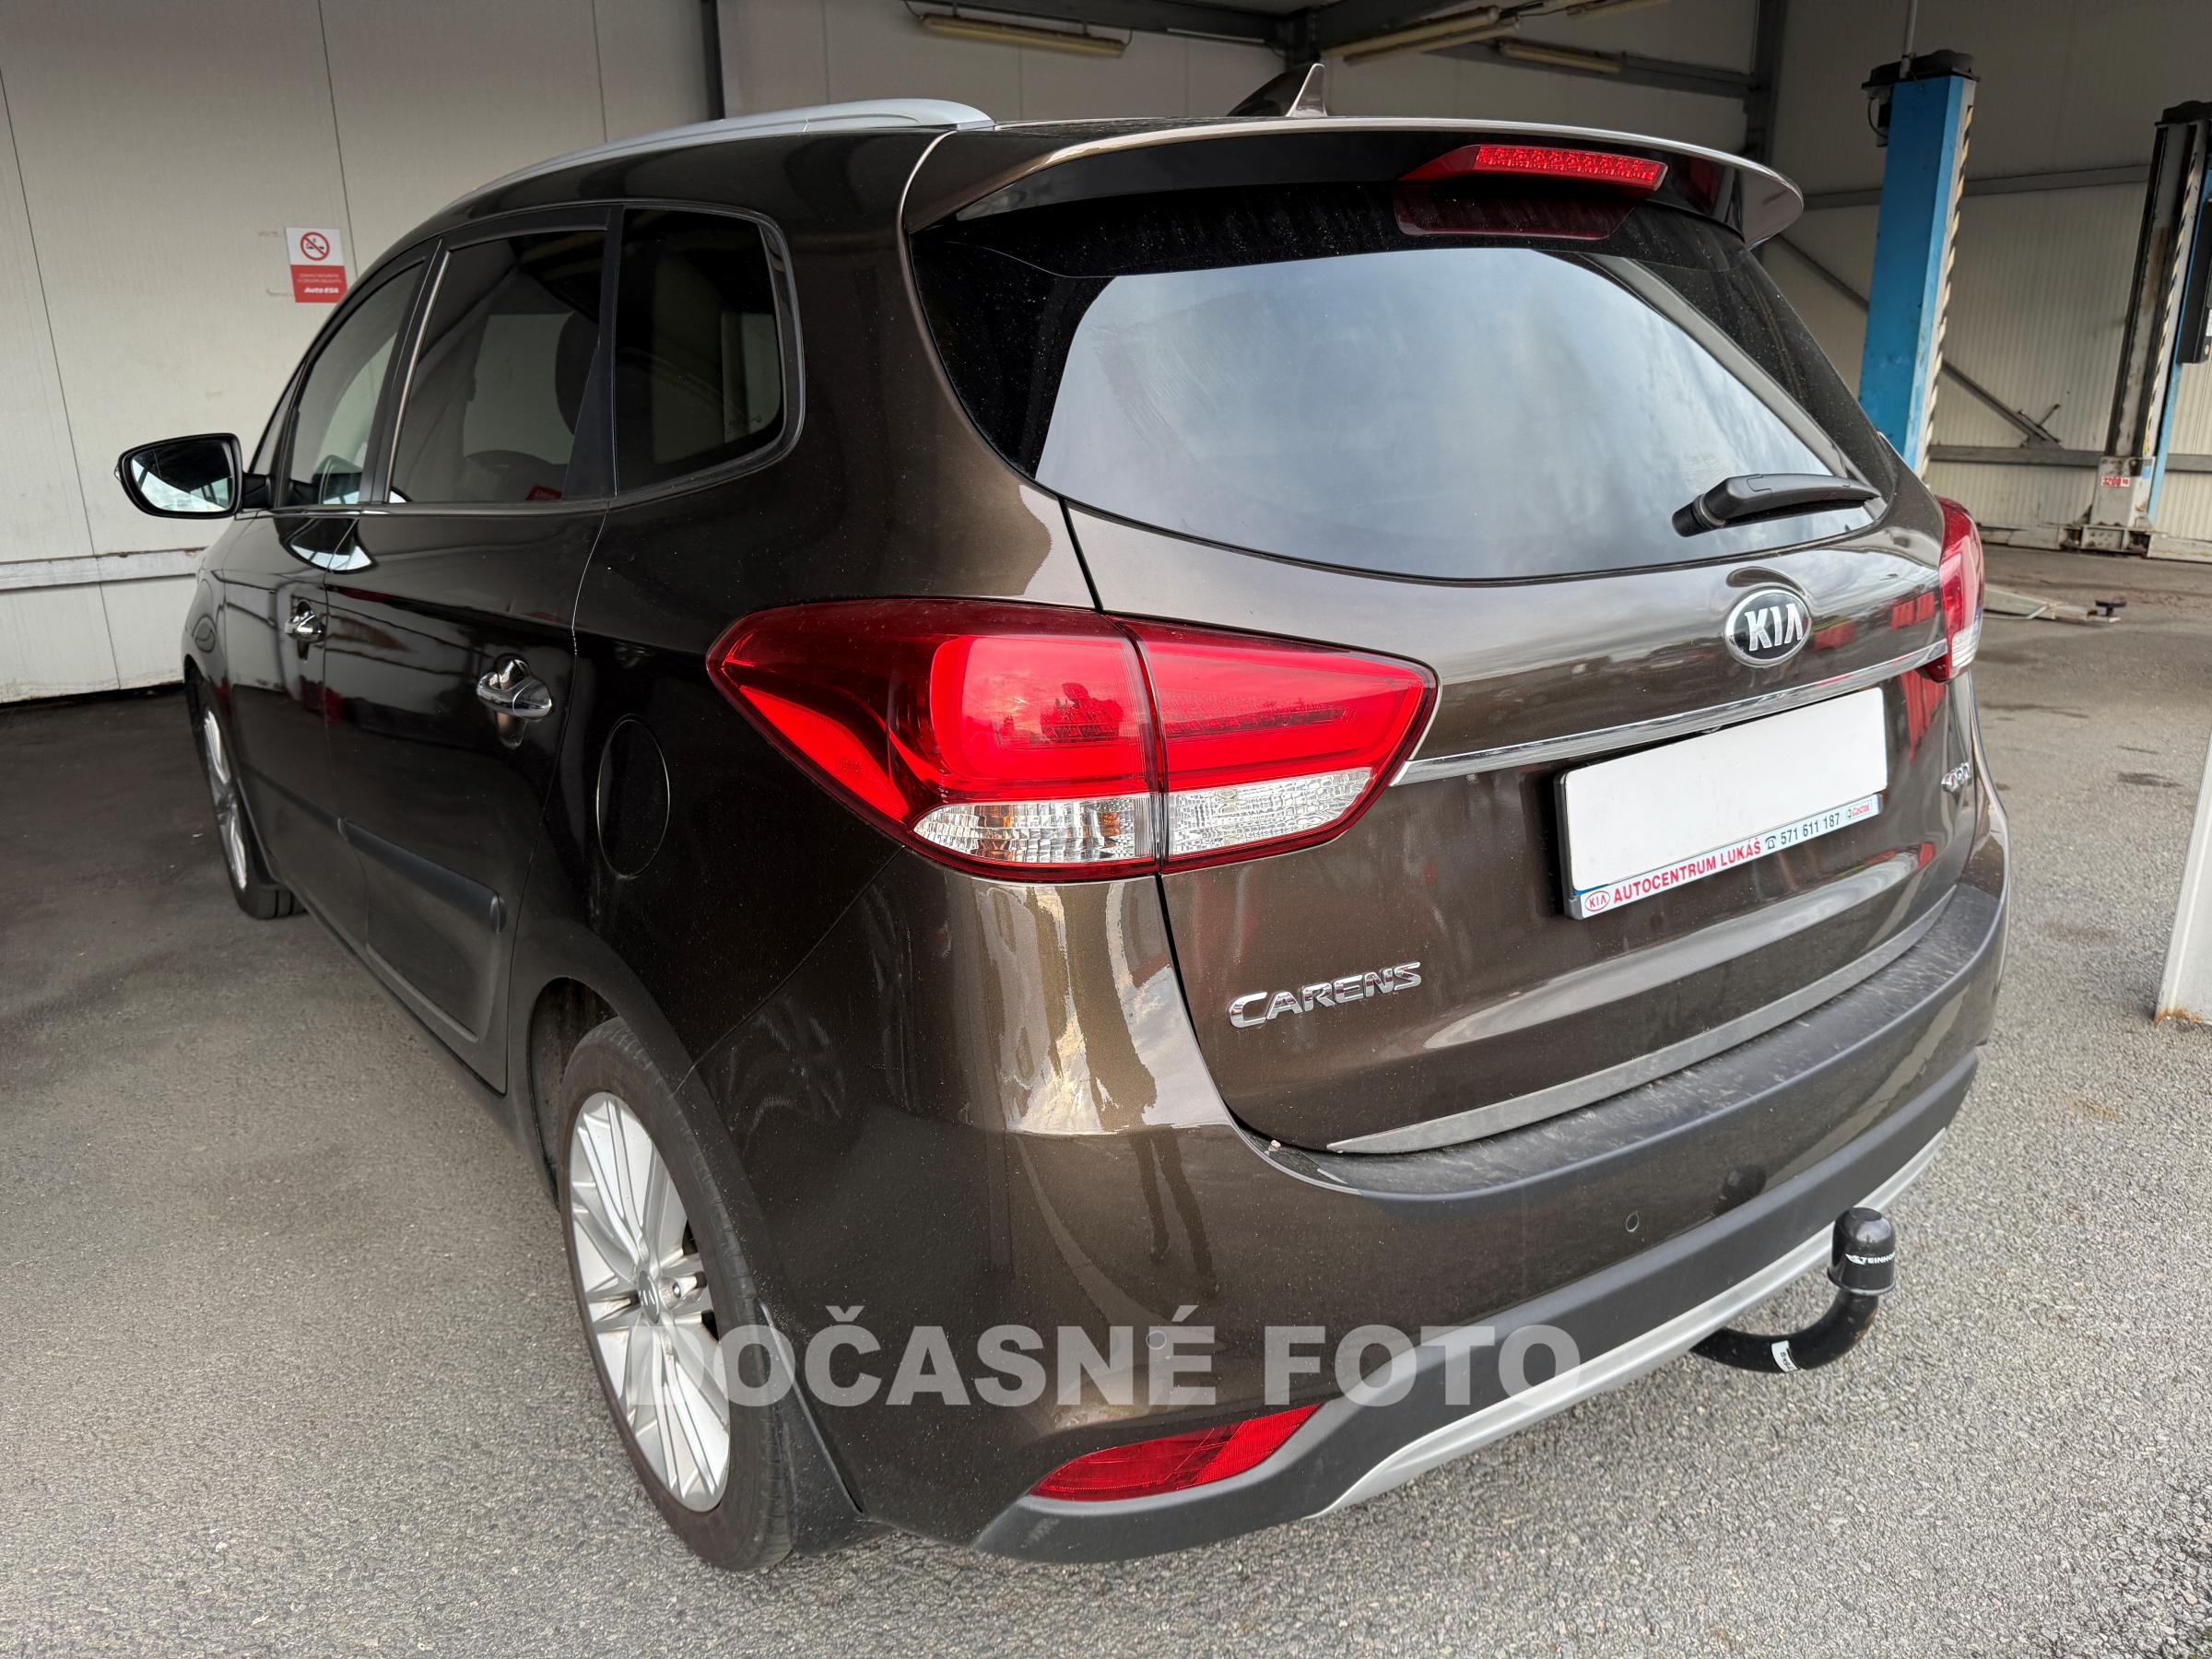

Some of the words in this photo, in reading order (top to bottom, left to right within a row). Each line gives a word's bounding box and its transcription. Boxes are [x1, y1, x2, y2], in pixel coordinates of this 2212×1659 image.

[1744, 603, 1804, 652] KIA
[1613, 854, 1717, 904] AUTOCENTRUM
[1720, 836, 1762, 866] LUKÁŠ
[1780, 828, 1798, 846] 571
[1802, 821, 1819, 838] 611
[1823, 812, 1841, 830] 187
[1588, 893, 1607, 908] KIA
[1228, 961, 1423, 1029] CARENS
